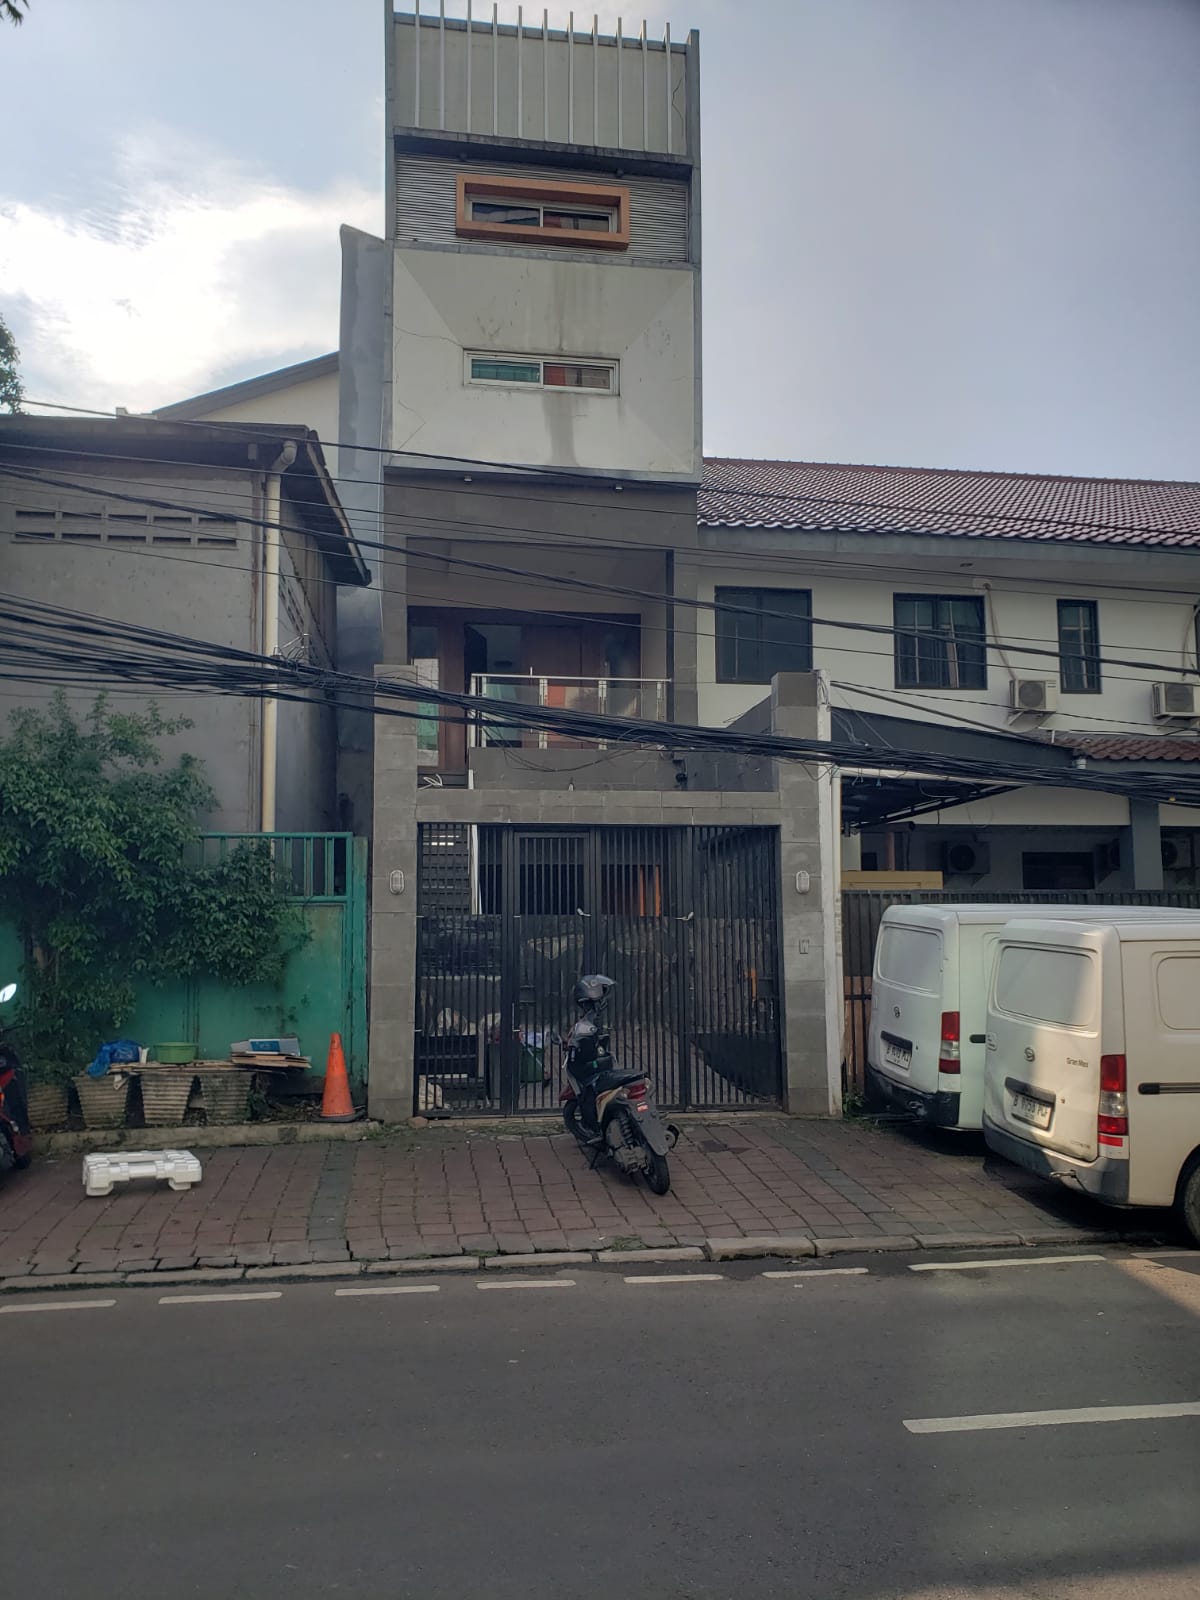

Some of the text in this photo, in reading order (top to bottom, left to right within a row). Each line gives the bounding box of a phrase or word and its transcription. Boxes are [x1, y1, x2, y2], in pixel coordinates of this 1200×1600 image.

[1066, 1057, 1089, 1068] Gran Max
[1013, 1094, 1019, 1106] B
